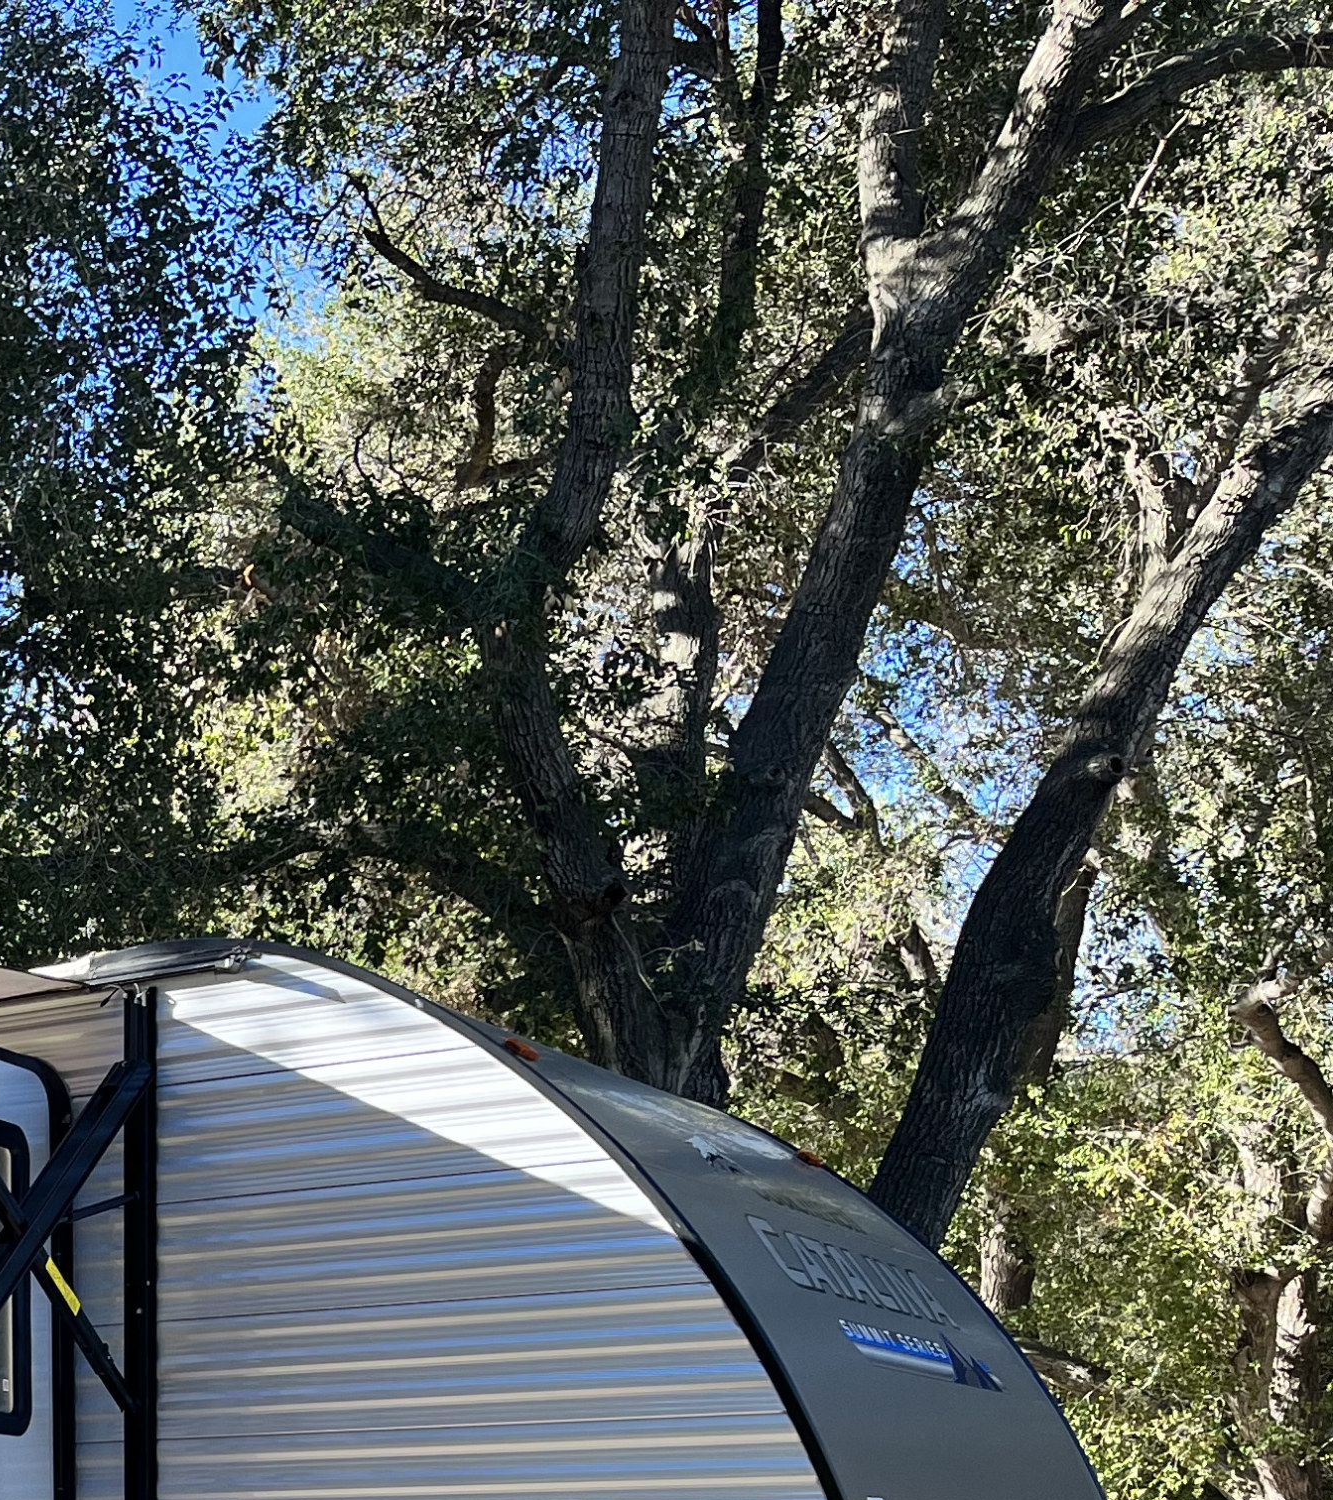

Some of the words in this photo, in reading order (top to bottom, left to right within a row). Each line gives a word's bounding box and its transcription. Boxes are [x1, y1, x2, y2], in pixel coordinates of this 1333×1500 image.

[744, 1213, 960, 1331] CATALINA
[838, 1318, 897, 1347] SUMMIT
[895, 1332, 947, 1359] SERIES
